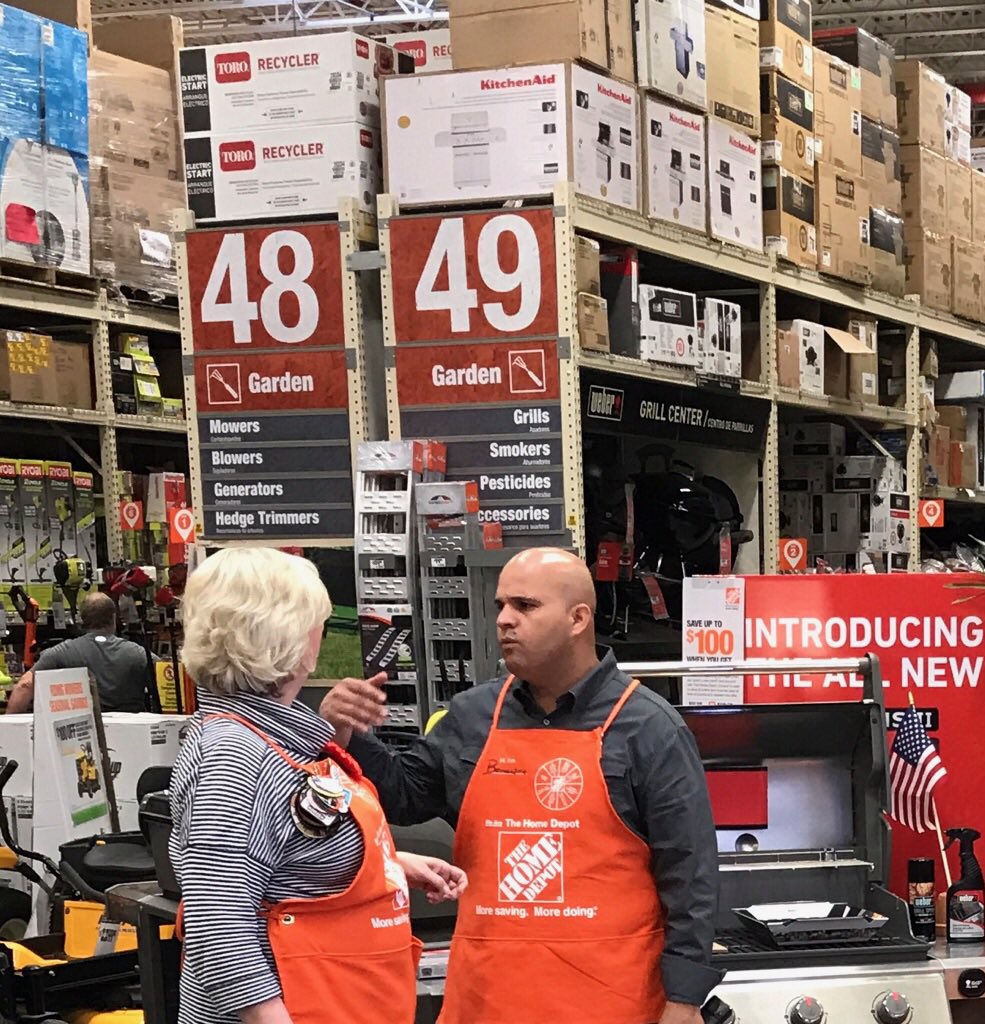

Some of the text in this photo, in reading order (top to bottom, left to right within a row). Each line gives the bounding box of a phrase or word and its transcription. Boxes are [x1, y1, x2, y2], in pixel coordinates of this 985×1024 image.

[257, 53, 319, 71] RECYCLER
[181, 74, 207, 82] ELECTRIC
[181, 82, 208, 91] START
[480, 74, 556, 91] KitchenAid
[597, 83, 632, 105] KitchenAid
[669, 112, 701, 132] KitchenAid
[262, 142, 324, 159] RECYCLER
[728, 135, 757, 156] KitchenAid
[186, 161, 212, 170] ELECTRIC
[186, 169, 213, 178] START
[415, 214, 542, 333] 49
[201, 229, 320, 344] 48
[248, 372, 314, 394] Garden
[432, 363, 502, 387] Garden
[590, 385, 616, 415] weber
[513, 409, 550, 425] Grills
[639, 400, 666, 422] GRILL
[668, 405, 703, 427] CENTER
[209, 419, 261, 434] Mowers
[211, 450, 263, 466] Blowers
[489, 442, 551, 458] Smokers
[21, 465, 43, 476] RYOBI
[49, 466, 70, 478] RYOBI
[214, 481, 284, 497] Generators
[480, 474, 552, 491] Pesticides
[215, 510, 320, 528] Hedge Trimmers
[477, 505, 550, 522] ccessories
[686, 619, 723, 628] SAVE UP TO
[744, 616, 984, 649] INTRODUCING
[686, 629, 735, 656] $100
[901, 656, 984, 688] NEW
[505, 818, 522, 828] The
[522, 818, 549, 828] Home
[550, 818, 580, 830] Depot
[504, 839, 531, 868] THE
[499, 831, 563, 901] HOME
[522, 857, 563, 901] DEPOT
[475, 905, 494, 916] More
[494, 905, 529, 919] saving.
[534, 906, 561, 918] More
[371, 916, 394, 929] More
